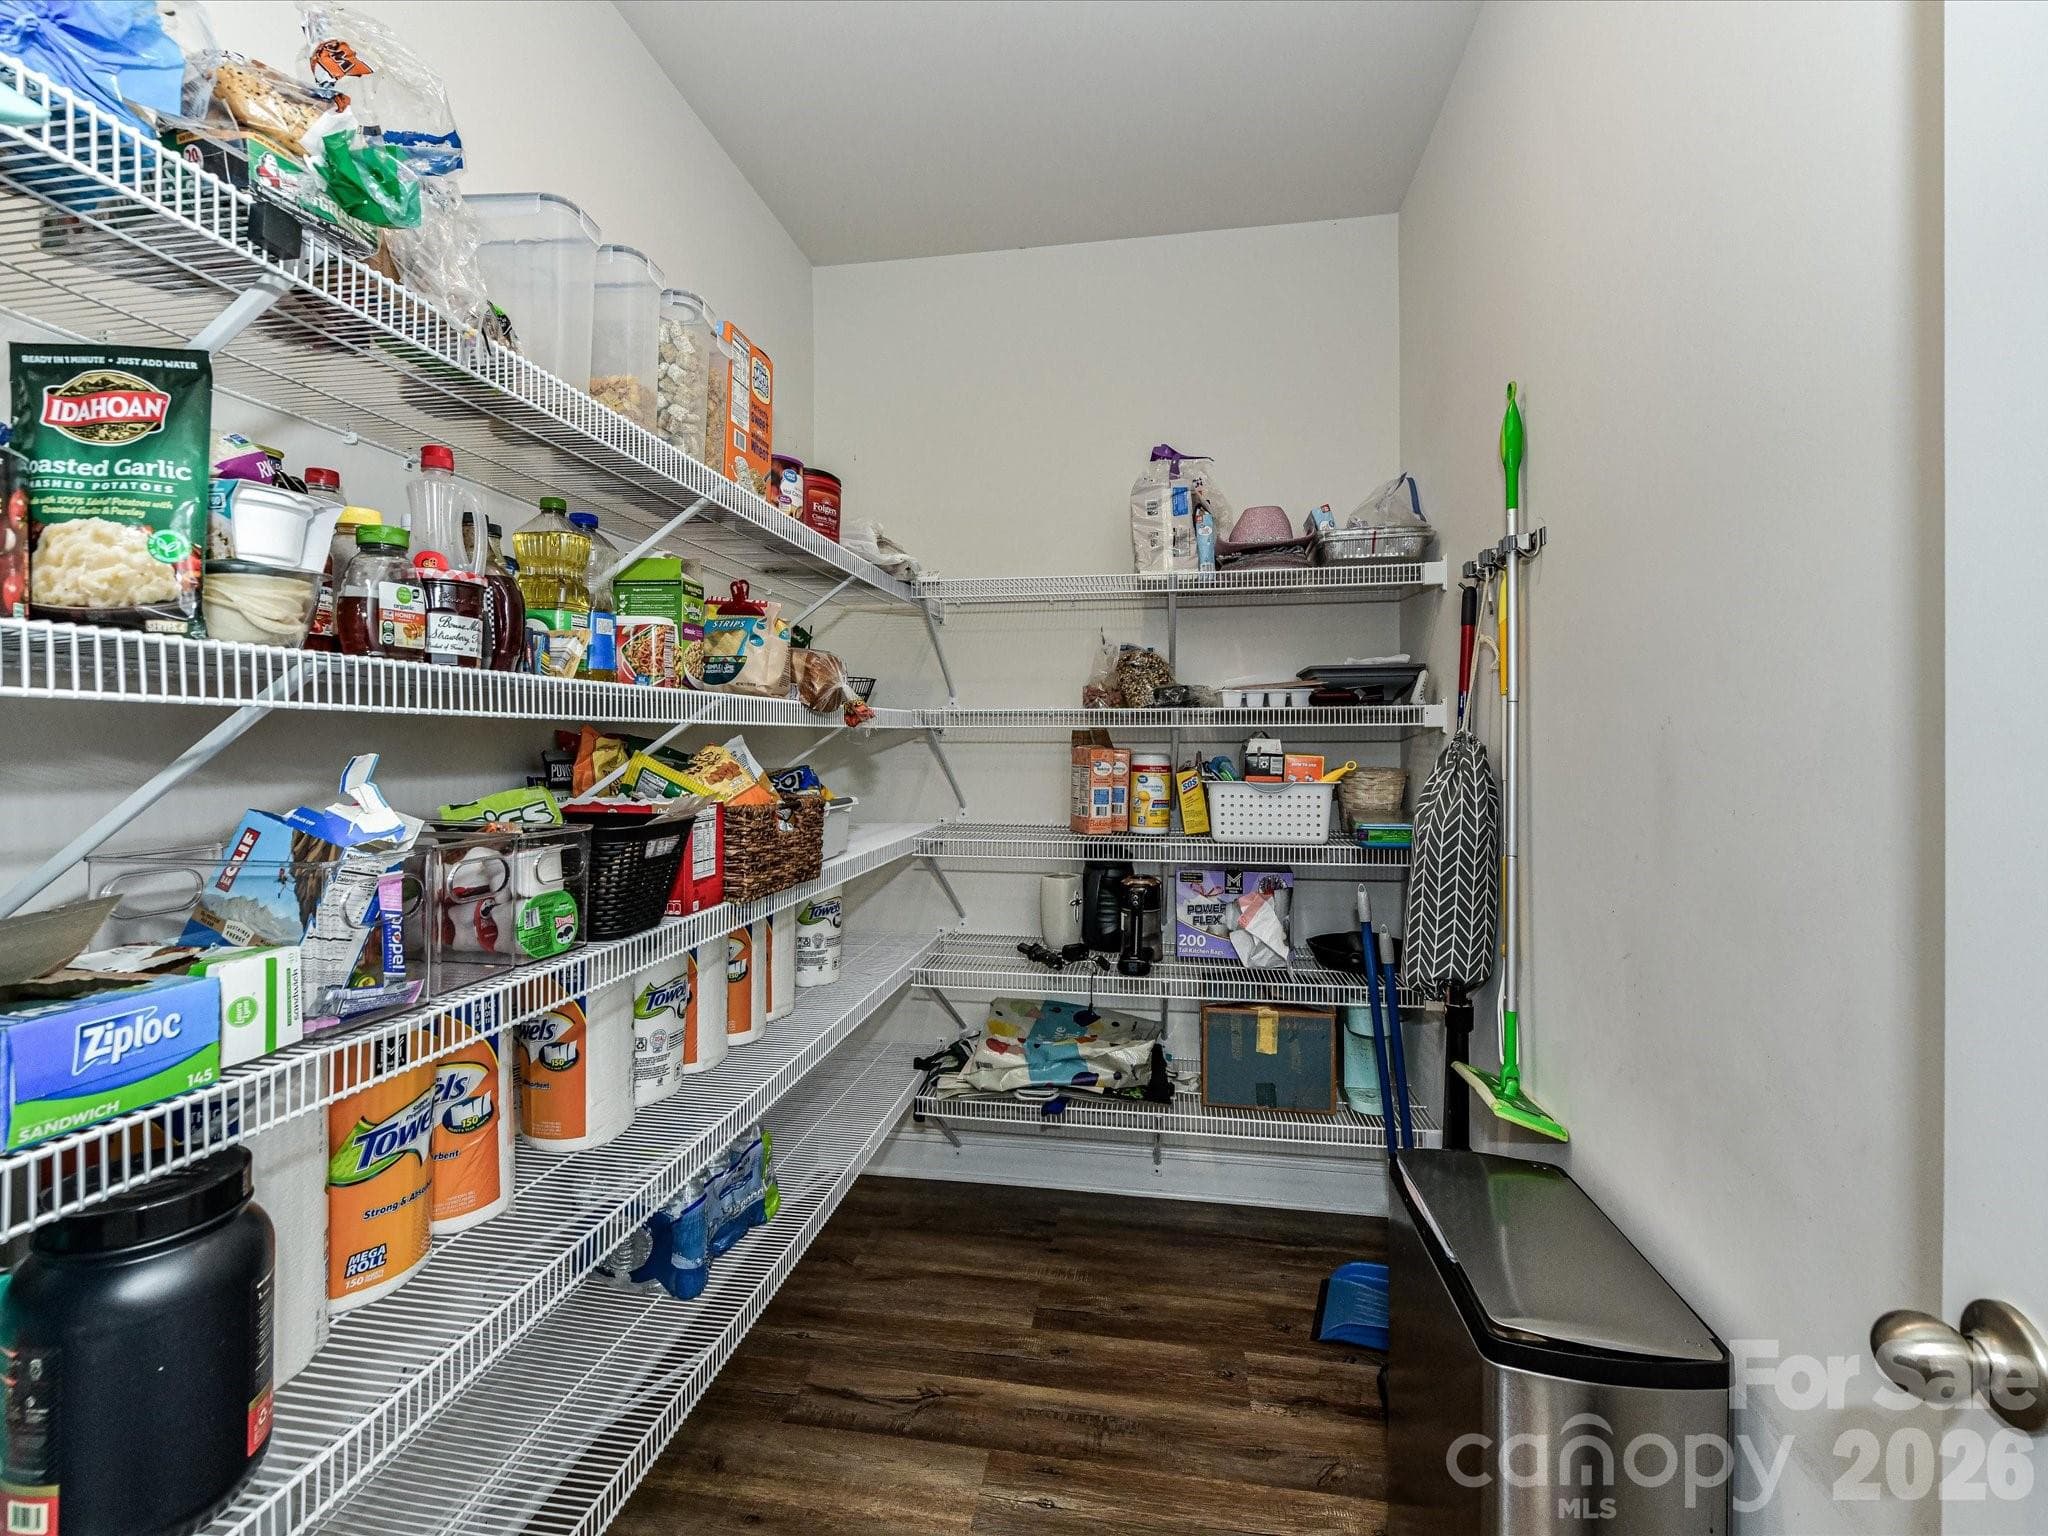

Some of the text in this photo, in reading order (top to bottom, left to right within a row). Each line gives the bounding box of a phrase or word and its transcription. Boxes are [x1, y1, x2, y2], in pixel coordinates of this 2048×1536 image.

[22, 355, 52, 364] READY
[70, 356, 105, 364] MINUTE
[116, 357, 141, 366] JUST
[143, 359, 163, 368] ADD
[163, 360, 199, 370] WATER
[50, 396, 163, 423] IDAHOAN
[114, 458, 193, 482] Garlic
[92, 480, 175, 494] POTATOES
[813, 501, 837, 516] Folgers
[712, 620, 746, 628] STRIPS
[551, 763, 574, 778] POWE
[1192, 915, 1221, 926] FLEX
[226, 923, 250, 940] SUSTAINED
[226, 931, 246, 944] ENERGY
[1178, 934, 1207, 947] 200
[82, 1012, 182, 1065] Ziploc
[519, 1022, 557, 1042] wels
[187, 1067, 214, 1088] 145
[17, 1099, 121, 1145] SANDWICH
[461, 1115, 479, 1128] 150
[352, 1111, 433, 1174] Towe
[362, 1203, 399, 1221] Strong
[400, 1196, 407, 1205] &
[350, 1245, 386, 1266] MEGA
[346, 1257, 386, 1278] ROLL
[345, 1275, 363, 1289] 150
